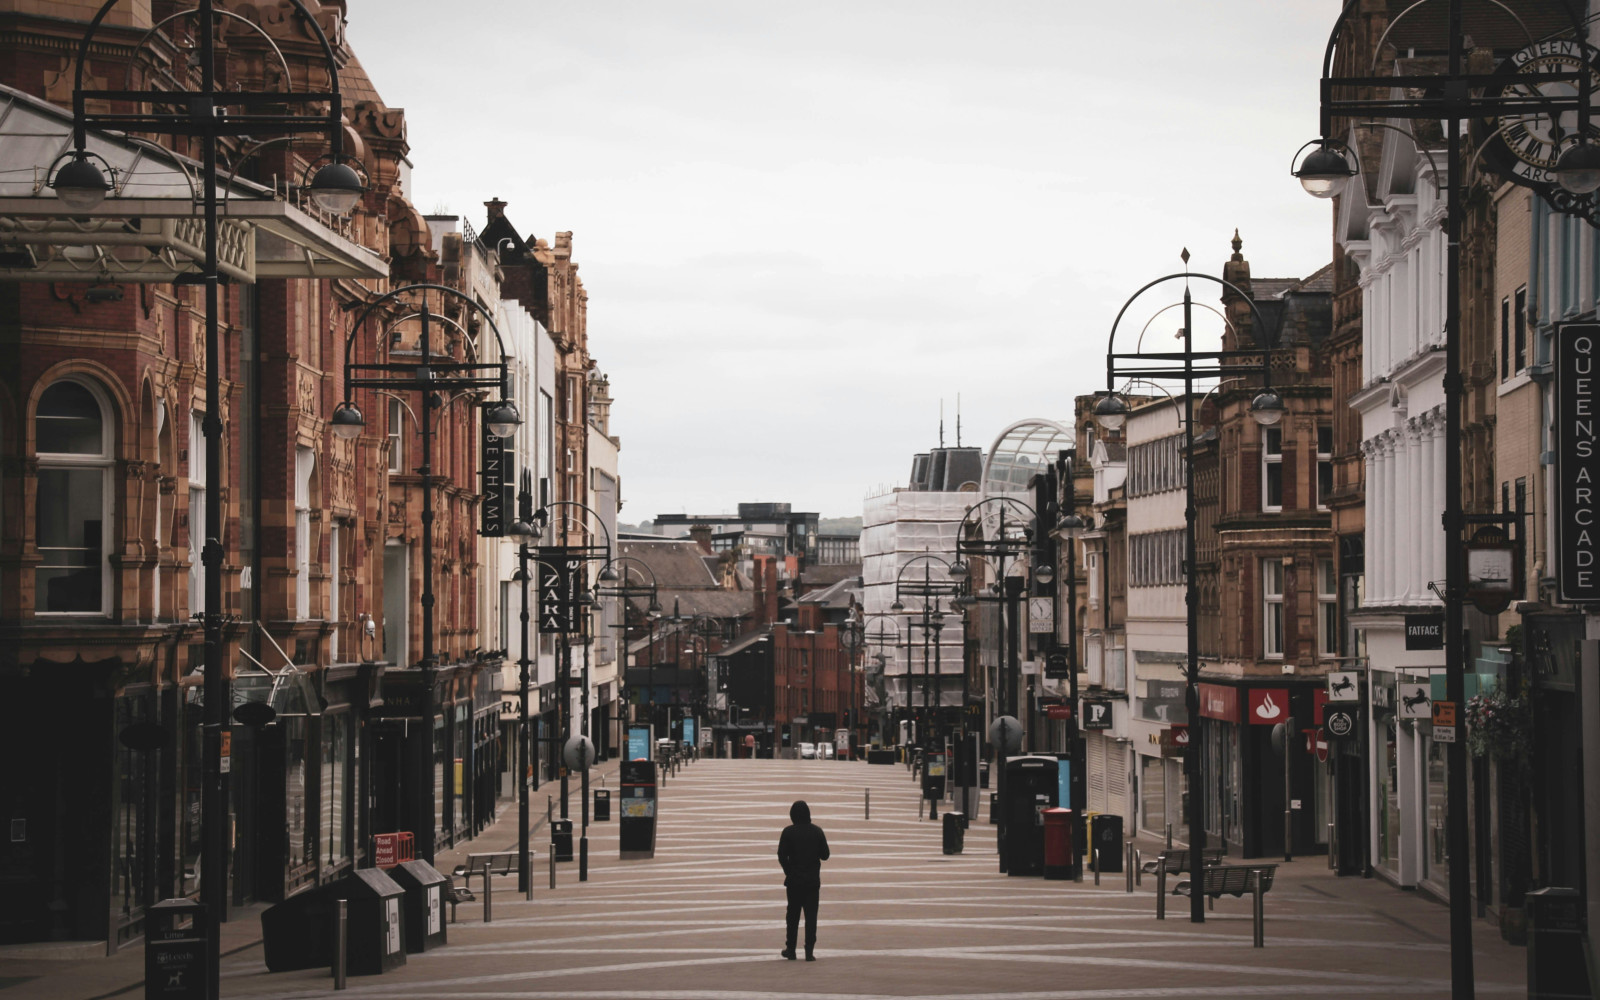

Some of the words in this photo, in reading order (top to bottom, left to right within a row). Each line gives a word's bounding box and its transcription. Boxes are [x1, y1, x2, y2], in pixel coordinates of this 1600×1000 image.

[1515, 40, 1592, 64] QUEENS
[1520, 166, 1554, 183] ARC
[1574, 336, 1596, 457] QUEEN'S
[485, 408, 500, 533] BENHAMS
[1574, 467, 1593, 588] ARCADE
[1477, 535, 1502, 544] SHIP
[543, 574, 561, 629] ZARA
[1408, 625, 1440, 636] FATFACE
[377, 837, 391, 845] Road
[376, 846, 393, 854] Ahead
[376, 855, 394, 864] Closed
[164, 932, 184, 940] Litter
